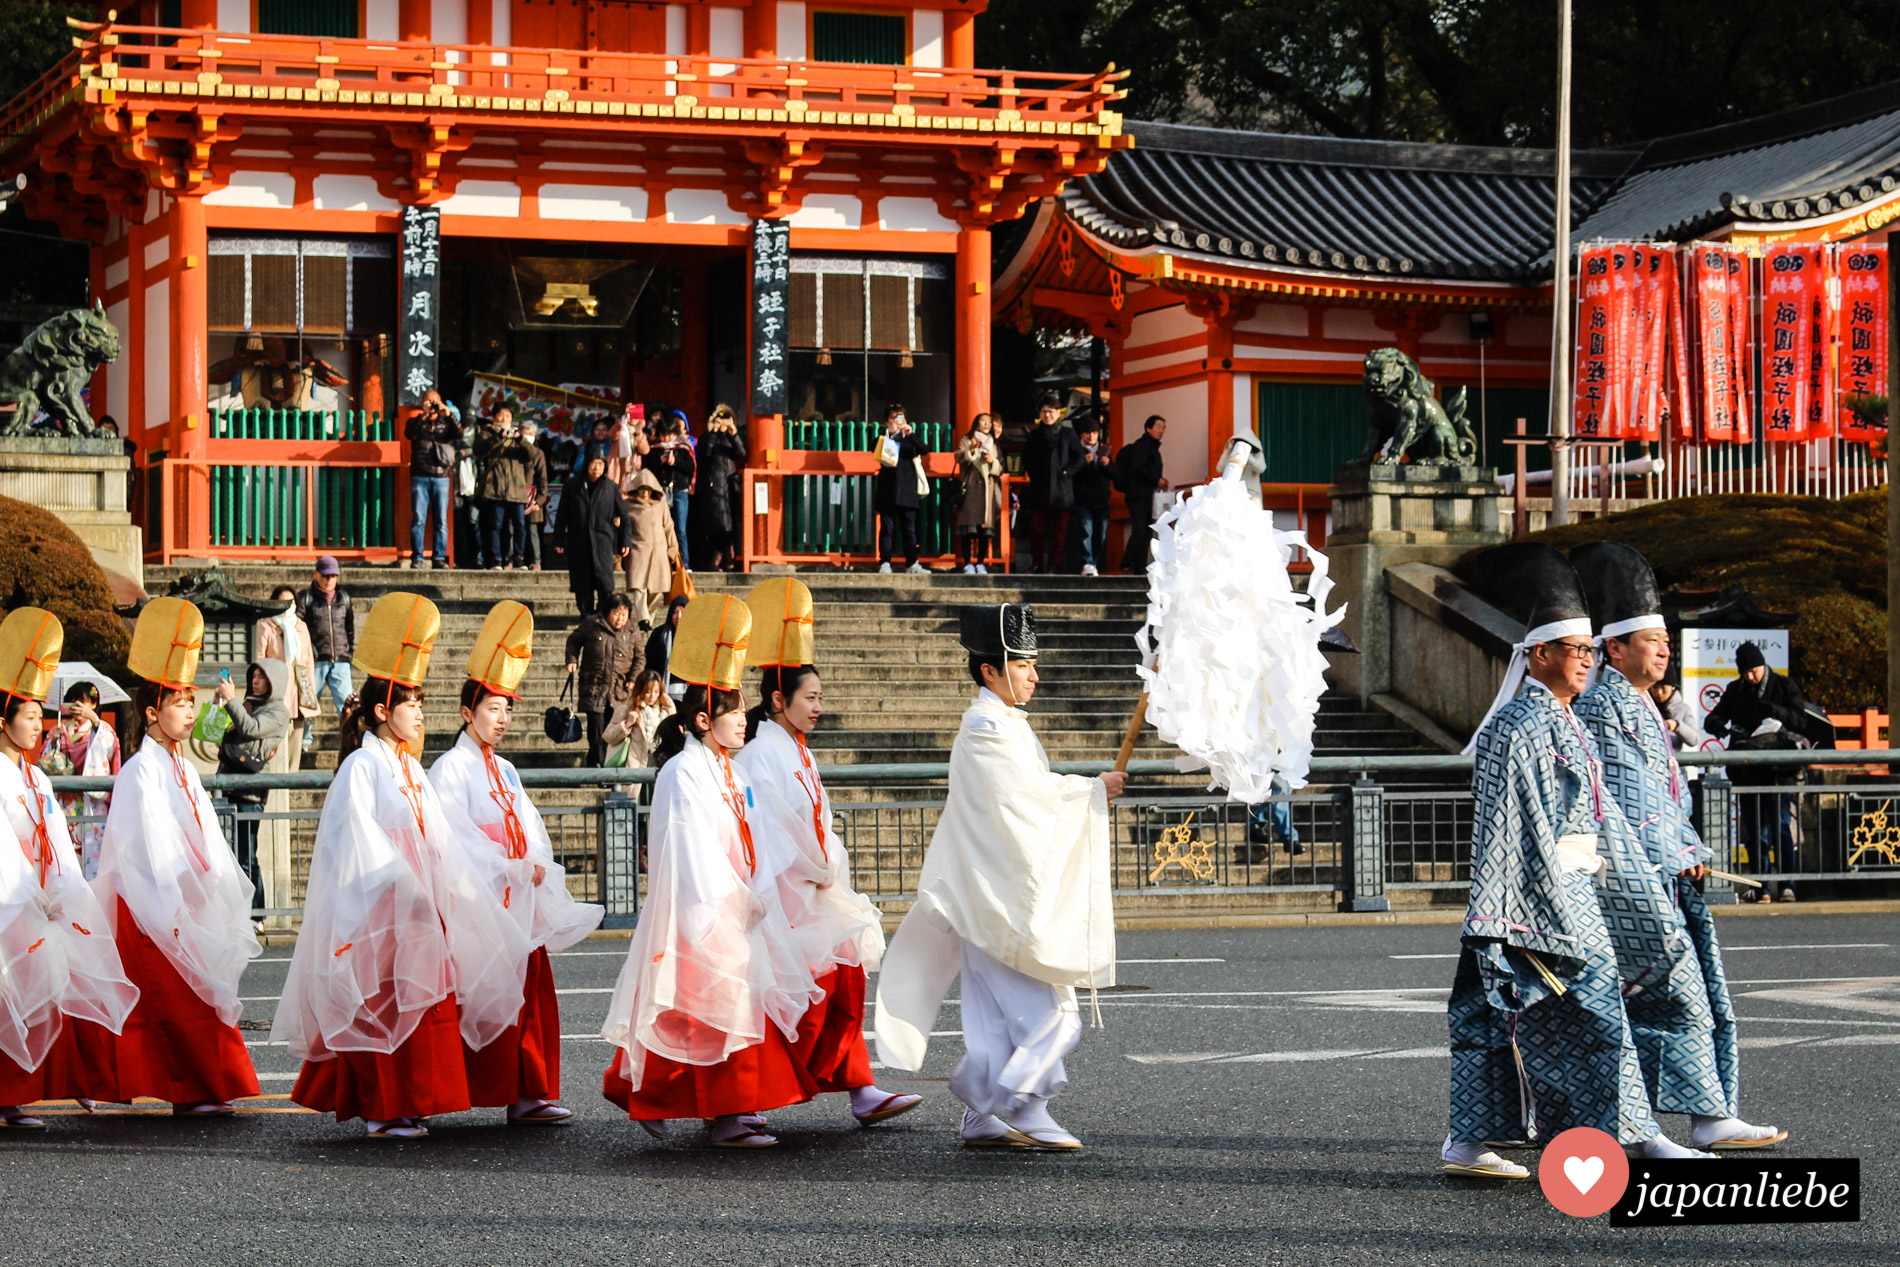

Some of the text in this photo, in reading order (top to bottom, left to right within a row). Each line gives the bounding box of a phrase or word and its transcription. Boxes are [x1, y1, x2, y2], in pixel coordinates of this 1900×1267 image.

[403, 206, 423, 277] 午前十時
[421, 211, 439, 276] 一月十五日
[772, 224, 789, 281] 一月十日
[404, 290, 434, 397] 月次祭
[756, 290, 785, 398] 蛭子社祭
